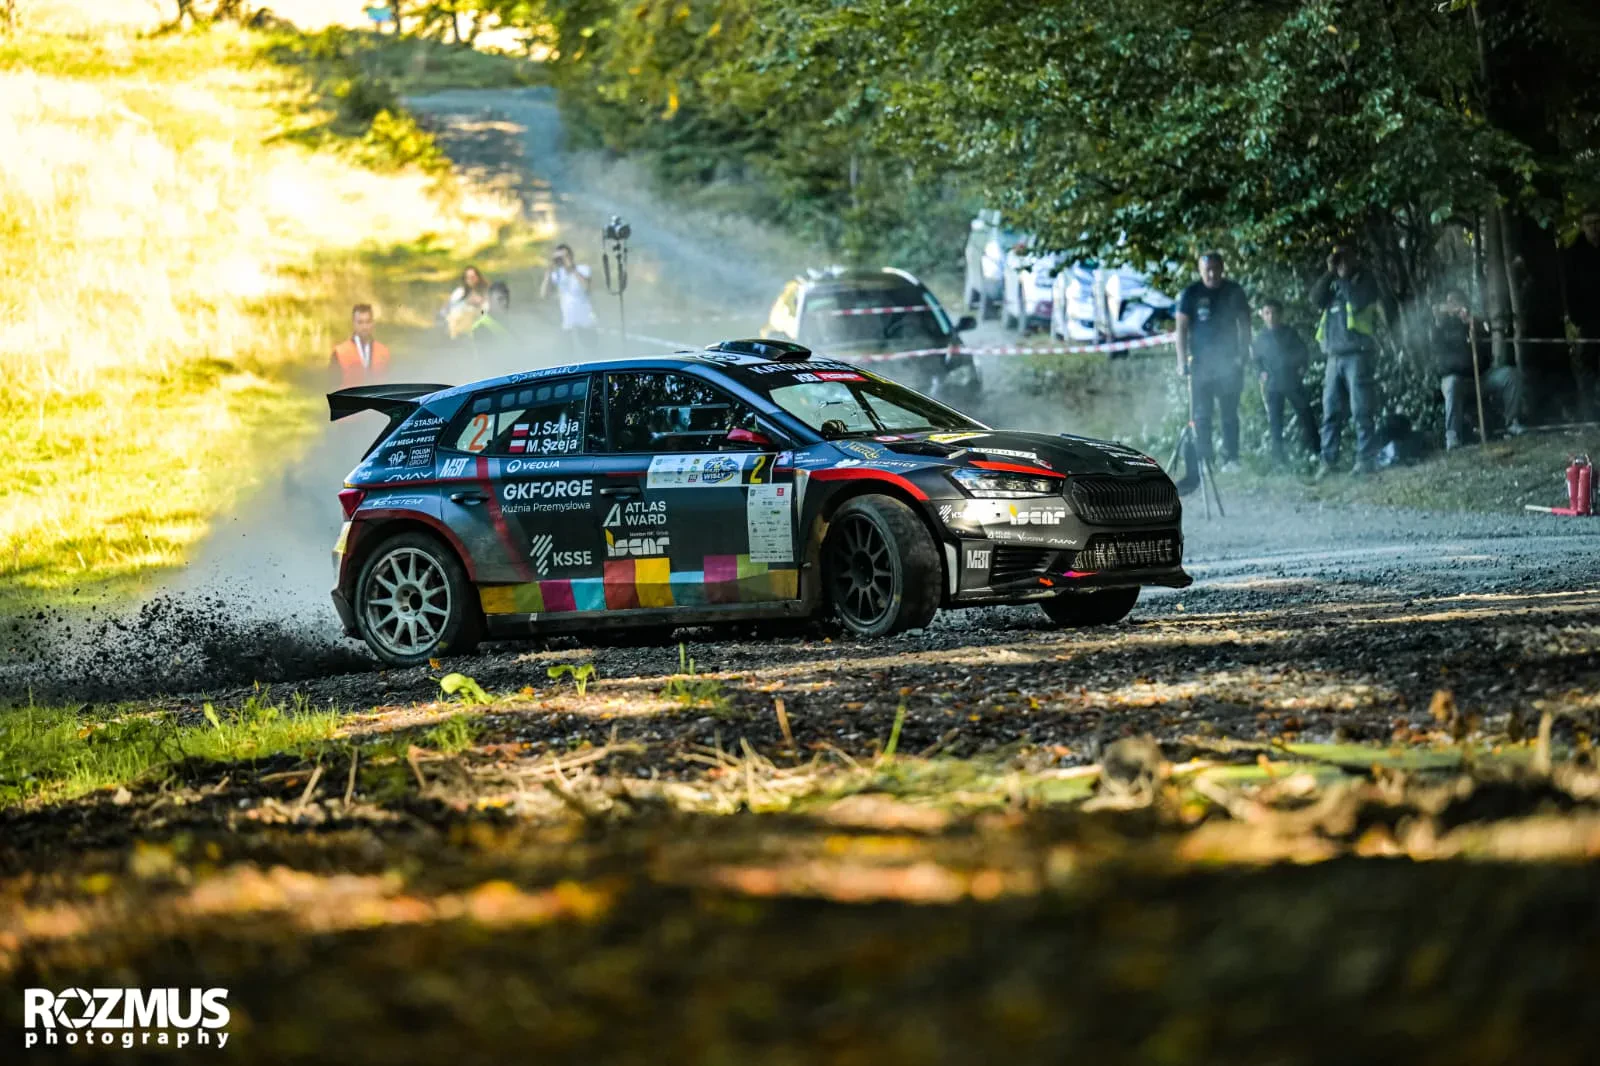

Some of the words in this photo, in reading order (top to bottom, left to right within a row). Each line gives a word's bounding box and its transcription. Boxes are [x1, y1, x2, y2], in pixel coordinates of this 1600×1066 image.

[469, 413, 489, 451] 2
[529, 419, 579, 437] J.Szeja
[526, 437, 577, 454] M.Szeja
[522, 459, 560, 470] VEOLIA
[749, 455, 767, 485] 2
[503, 479, 594, 501] GKFORGE
[501, 503, 531, 513] Kuźnia
[533, 501, 591, 513] Przemysłowa
[624, 500, 667, 514] ATLAS
[624, 513, 667, 526] WARD
[553, 550, 593, 567] KSSE
